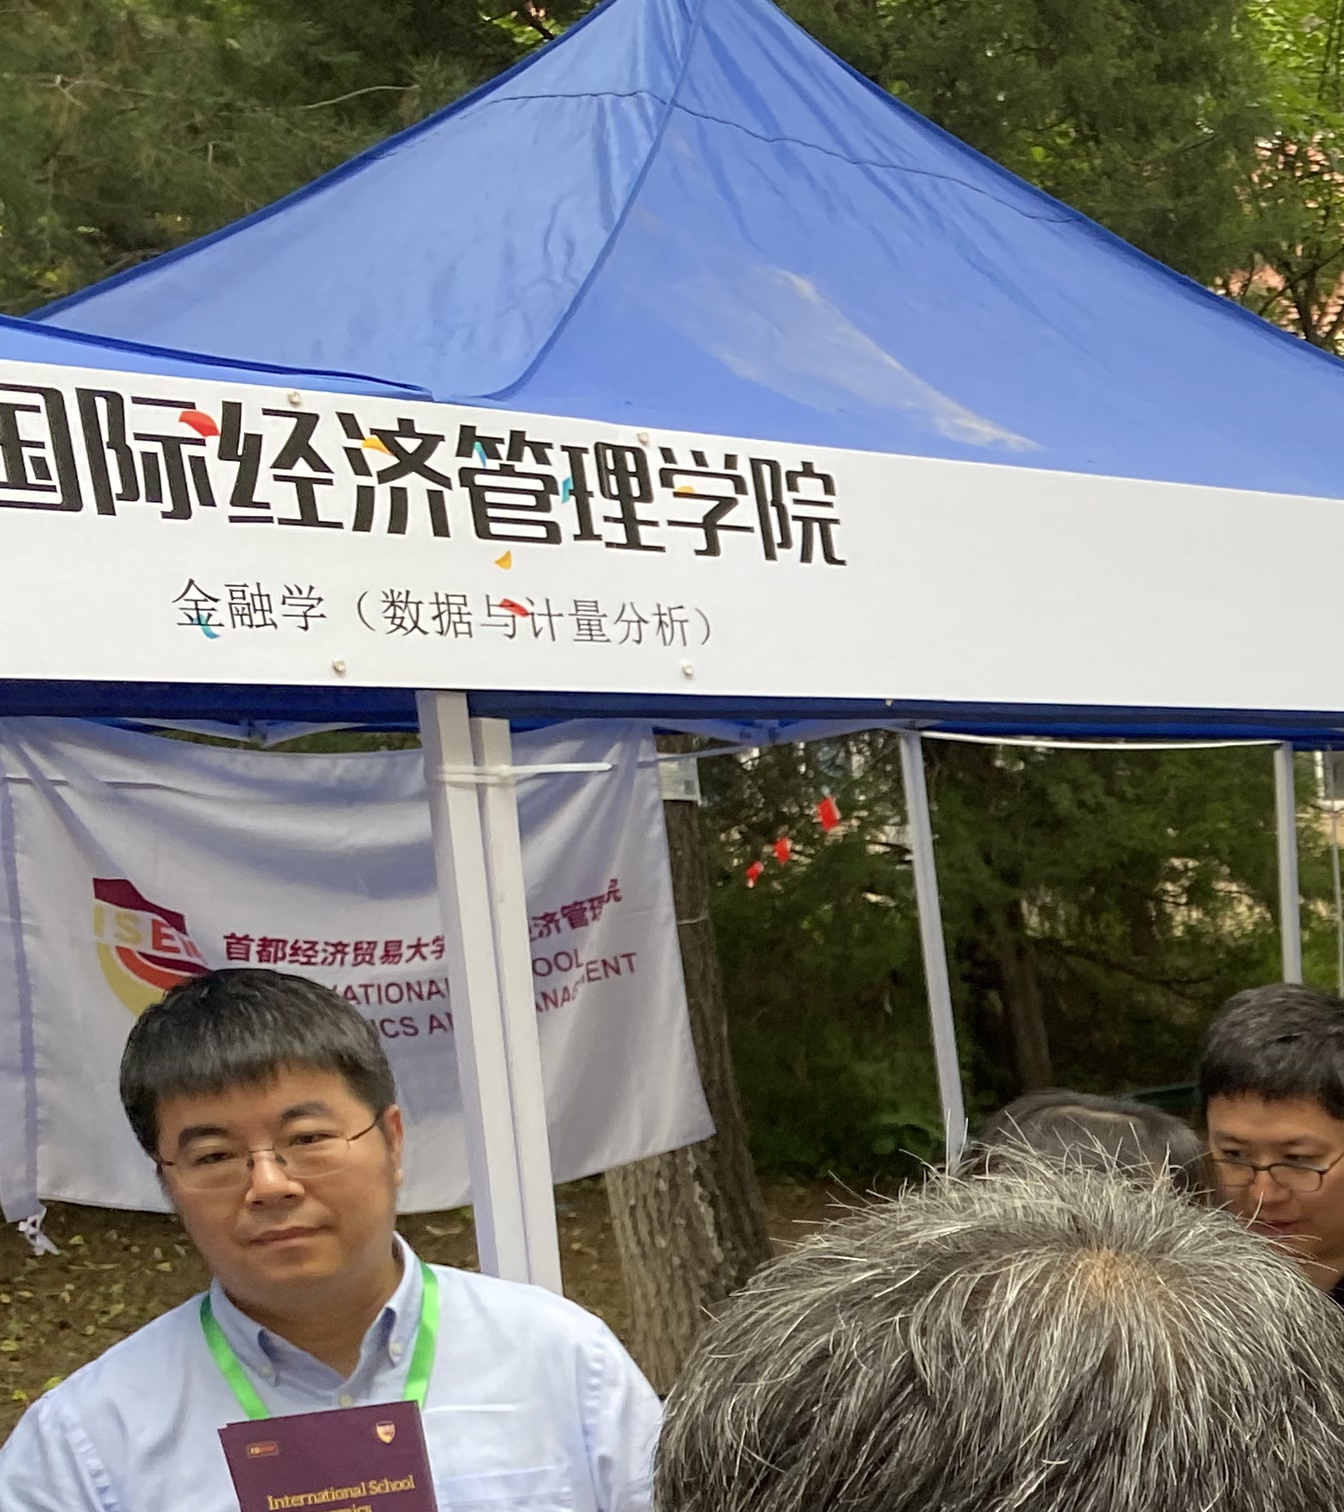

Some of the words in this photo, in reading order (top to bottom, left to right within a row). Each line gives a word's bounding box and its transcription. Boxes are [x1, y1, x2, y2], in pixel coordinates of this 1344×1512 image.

[0, 383, 848, 567] 国际经济管理学院
[172, 577, 715, 650] 金融学（数据与计量分析）
[267, 1482, 367, 1511] International
[369, 1475, 416, 1495] School
